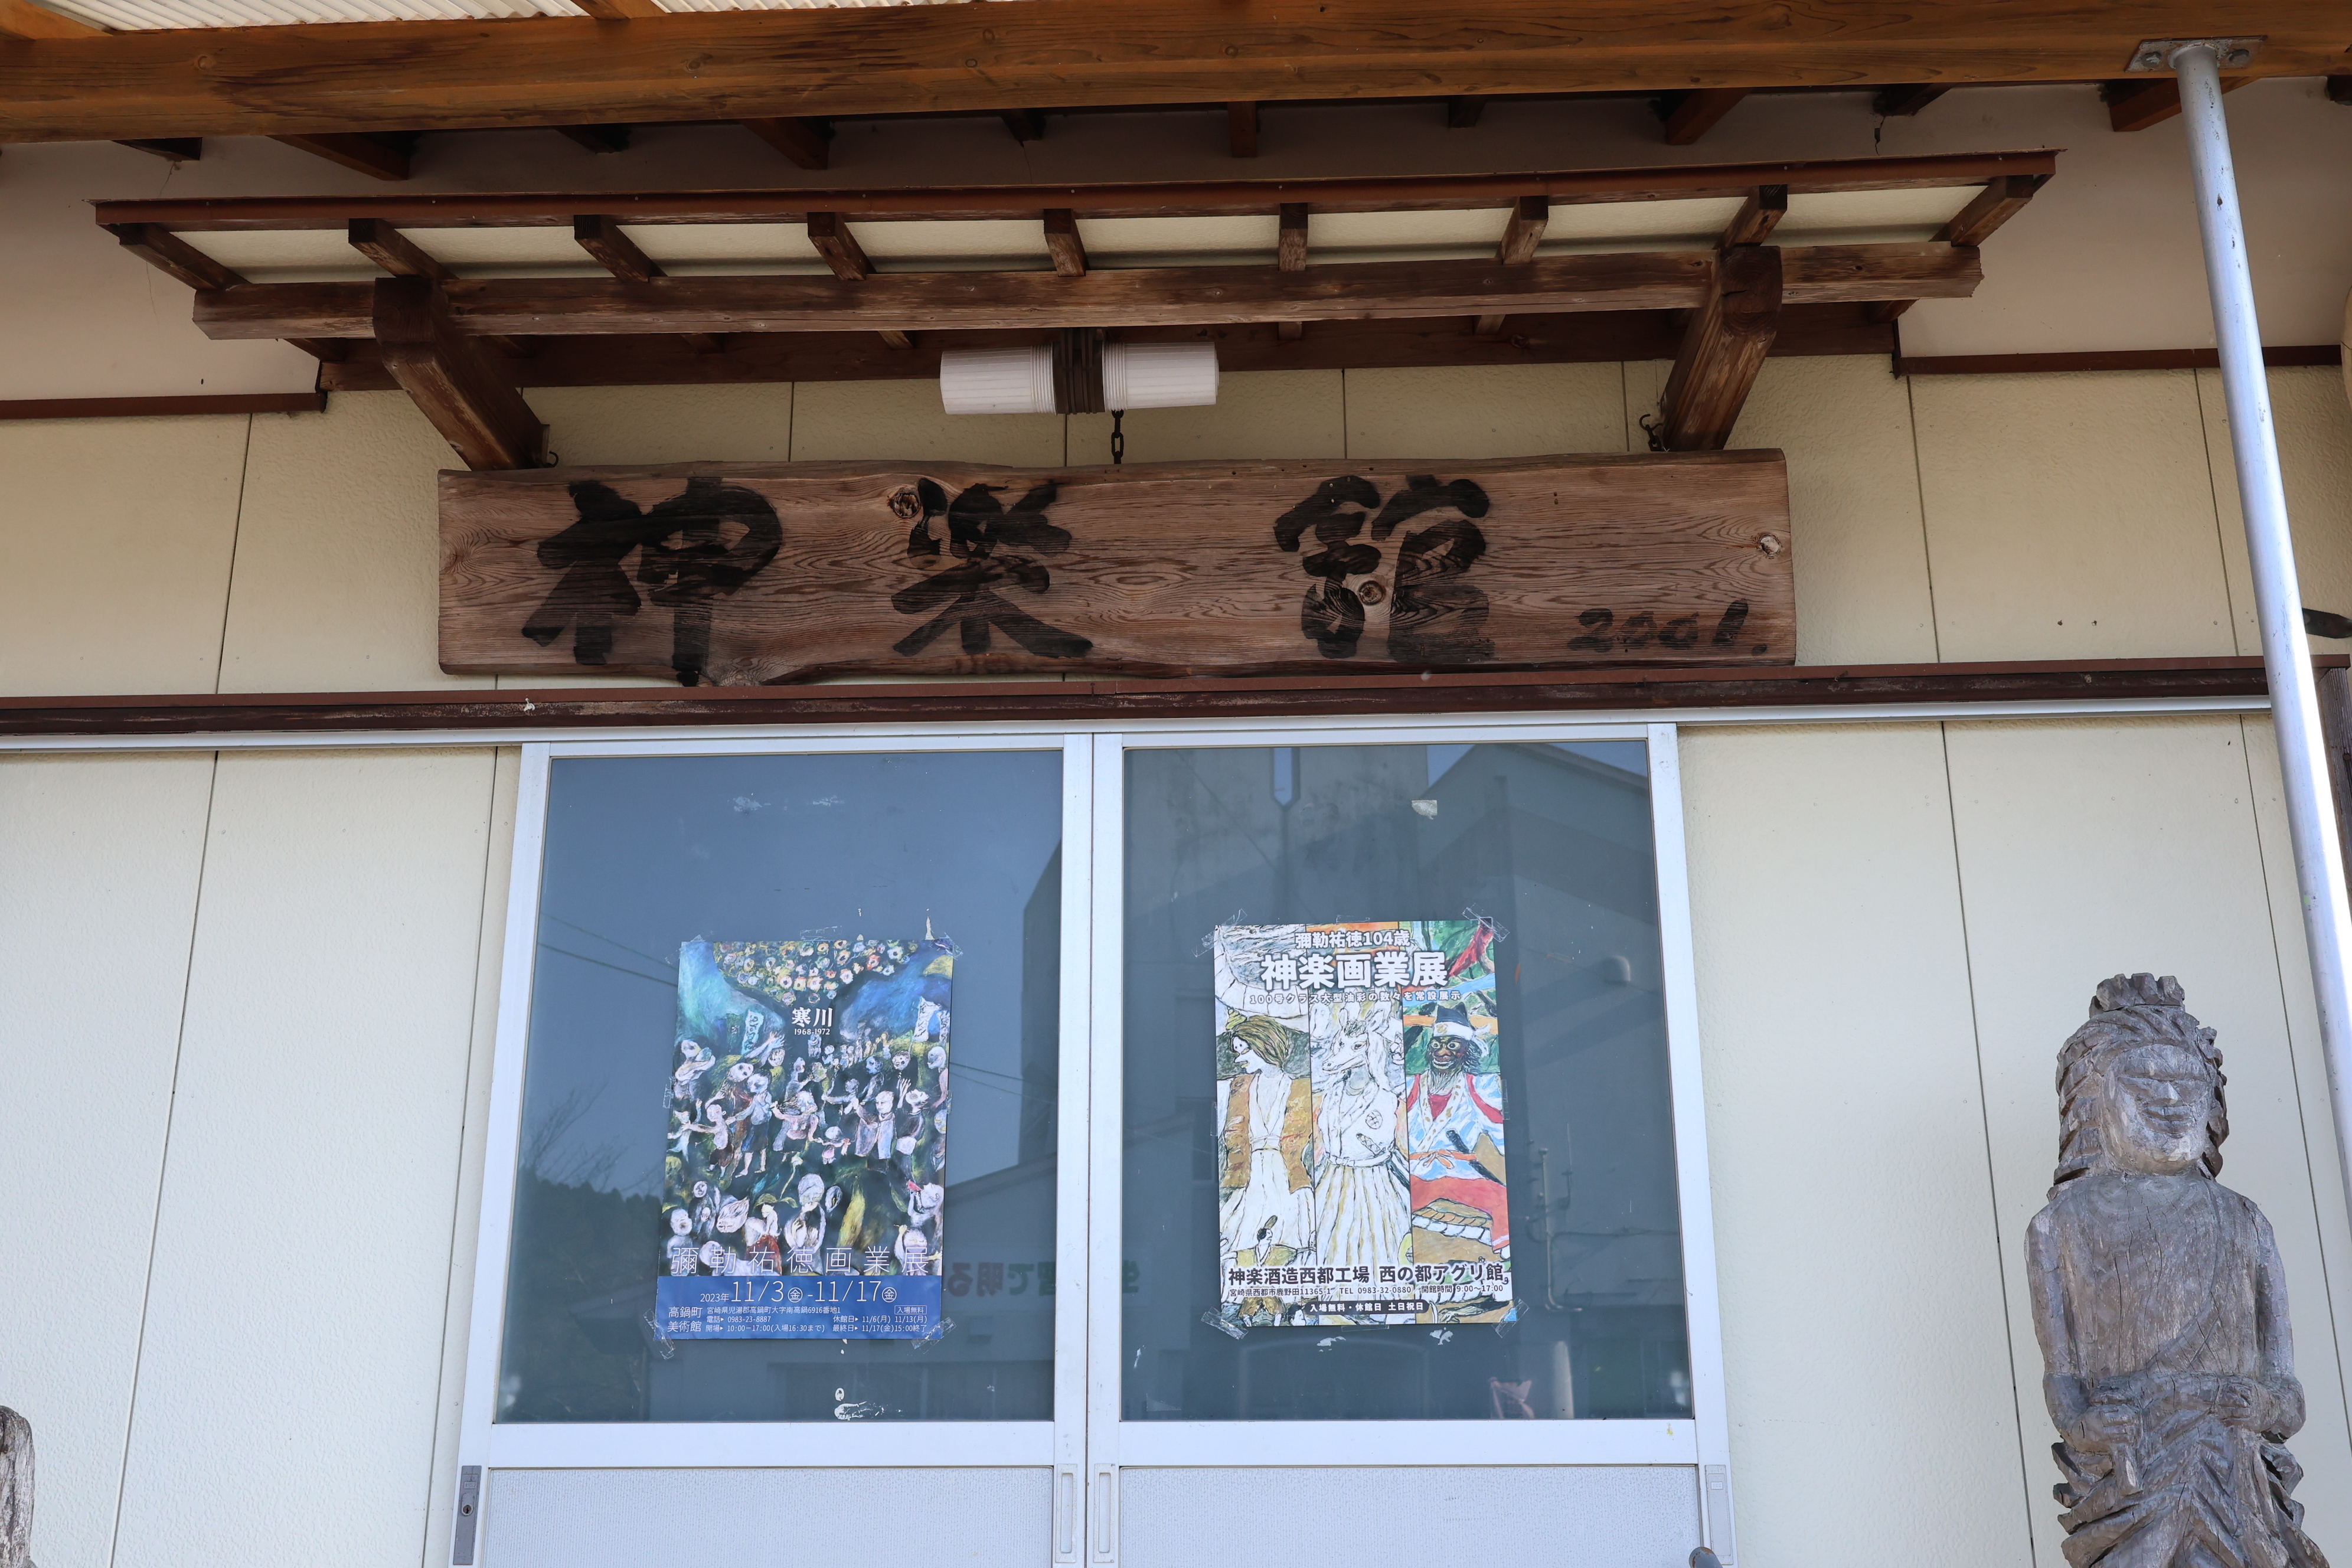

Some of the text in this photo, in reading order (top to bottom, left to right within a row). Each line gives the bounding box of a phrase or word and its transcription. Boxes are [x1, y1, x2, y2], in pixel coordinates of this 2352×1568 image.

[1260, 951, 1448, 990] 神楽画業展
[1250, 991, 1461, 1004] 100号クラス大型油彩の数々を常設展示
[792, 1007, 833, 1028] 寒川
[1228, 1263, 1503, 1286] 神楽酒造西都工場 西の都アグリ館
[1358, 1286, 1412, 1294] 0983-32-0880
[1421, 1285, 1452, 1293] 開館時間
[668, 1306, 703, 1318] 高鍋町
[707, 1306, 841, 1314] 宮崎県児湯郡高鍋町大字南高鍋6916番地1
[897, 1306, 925, 1314] 入場無料
[1388, 1302, 1423, 1311] 土日祝日
[667, 1321, 702, 1332] 美術館
